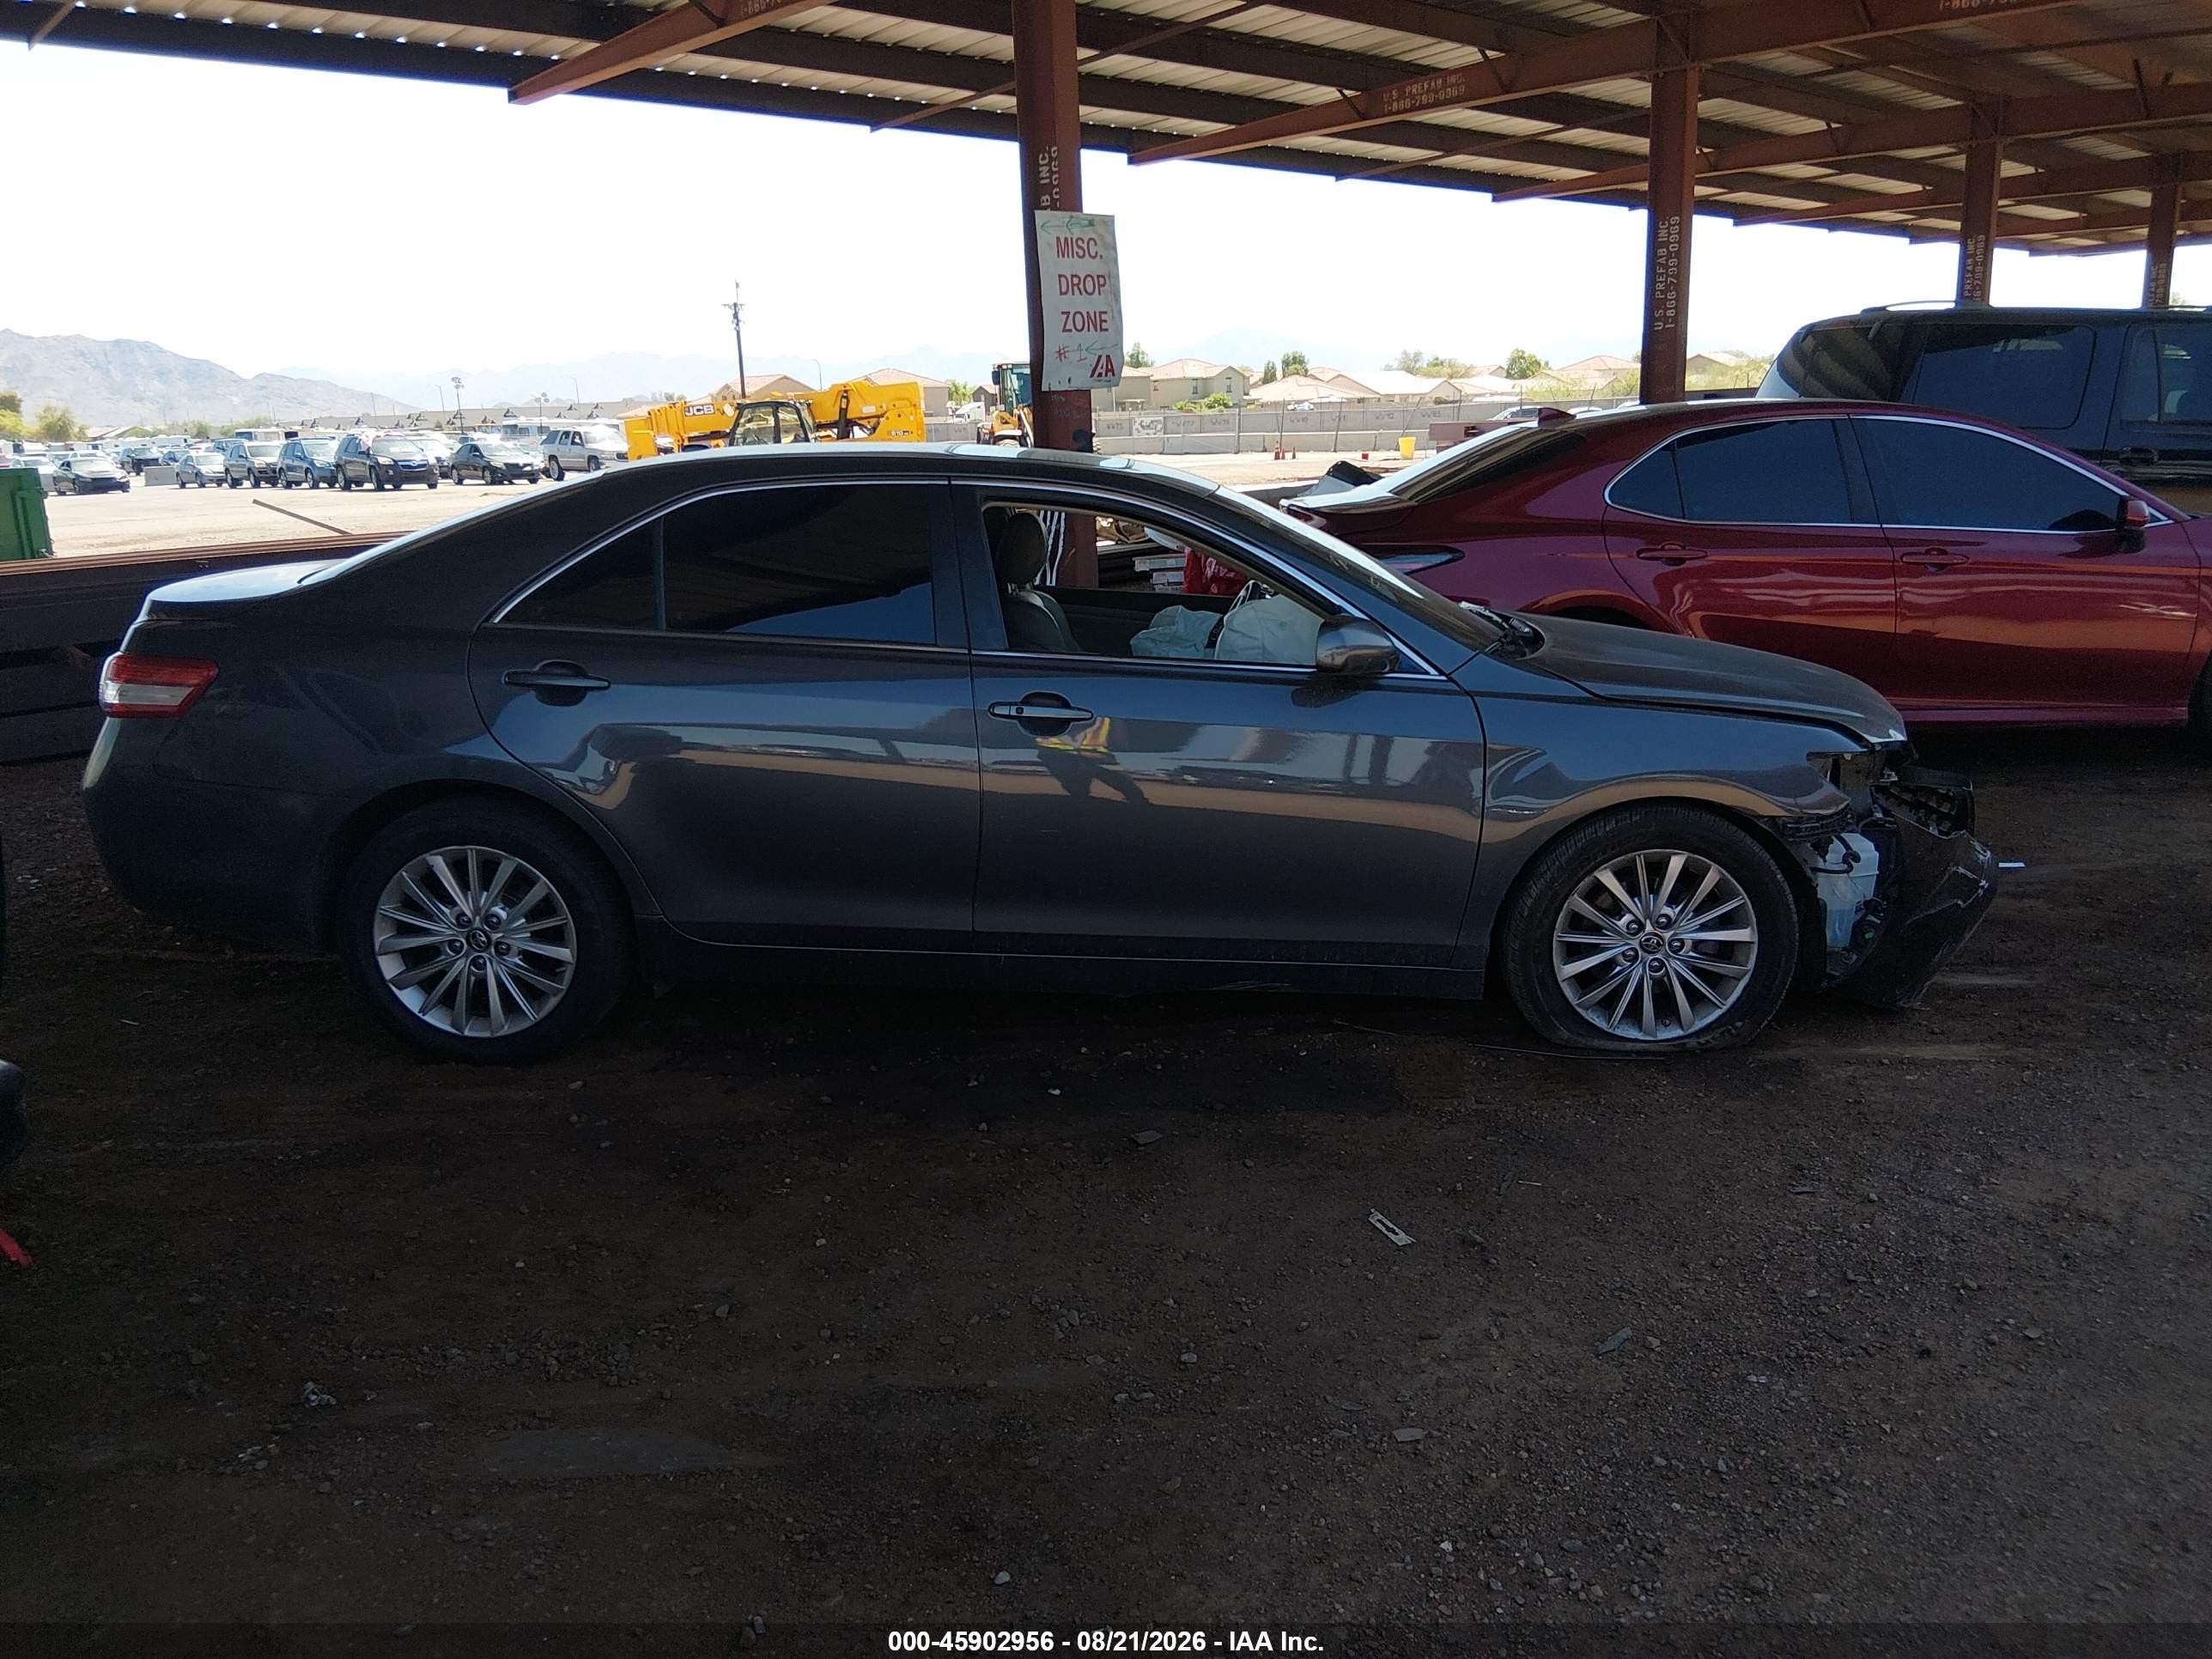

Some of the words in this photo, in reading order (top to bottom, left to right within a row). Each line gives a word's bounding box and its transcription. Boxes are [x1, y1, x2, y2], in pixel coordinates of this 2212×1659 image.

[1039, 146, 1049, 184] INC.
[1658, 216, 1668, 241] INC.
[1055, 236, 1103, 259] MISC.
[1656, 248, 1666, 298] PREFAB
[1666, 216, 1680, 329] 1-866-799-0969
[1058, 274, 1107, 296] DROP
[1060, 311, 1109, 333] ZONE
[685, 405, 714, 416] JCB
